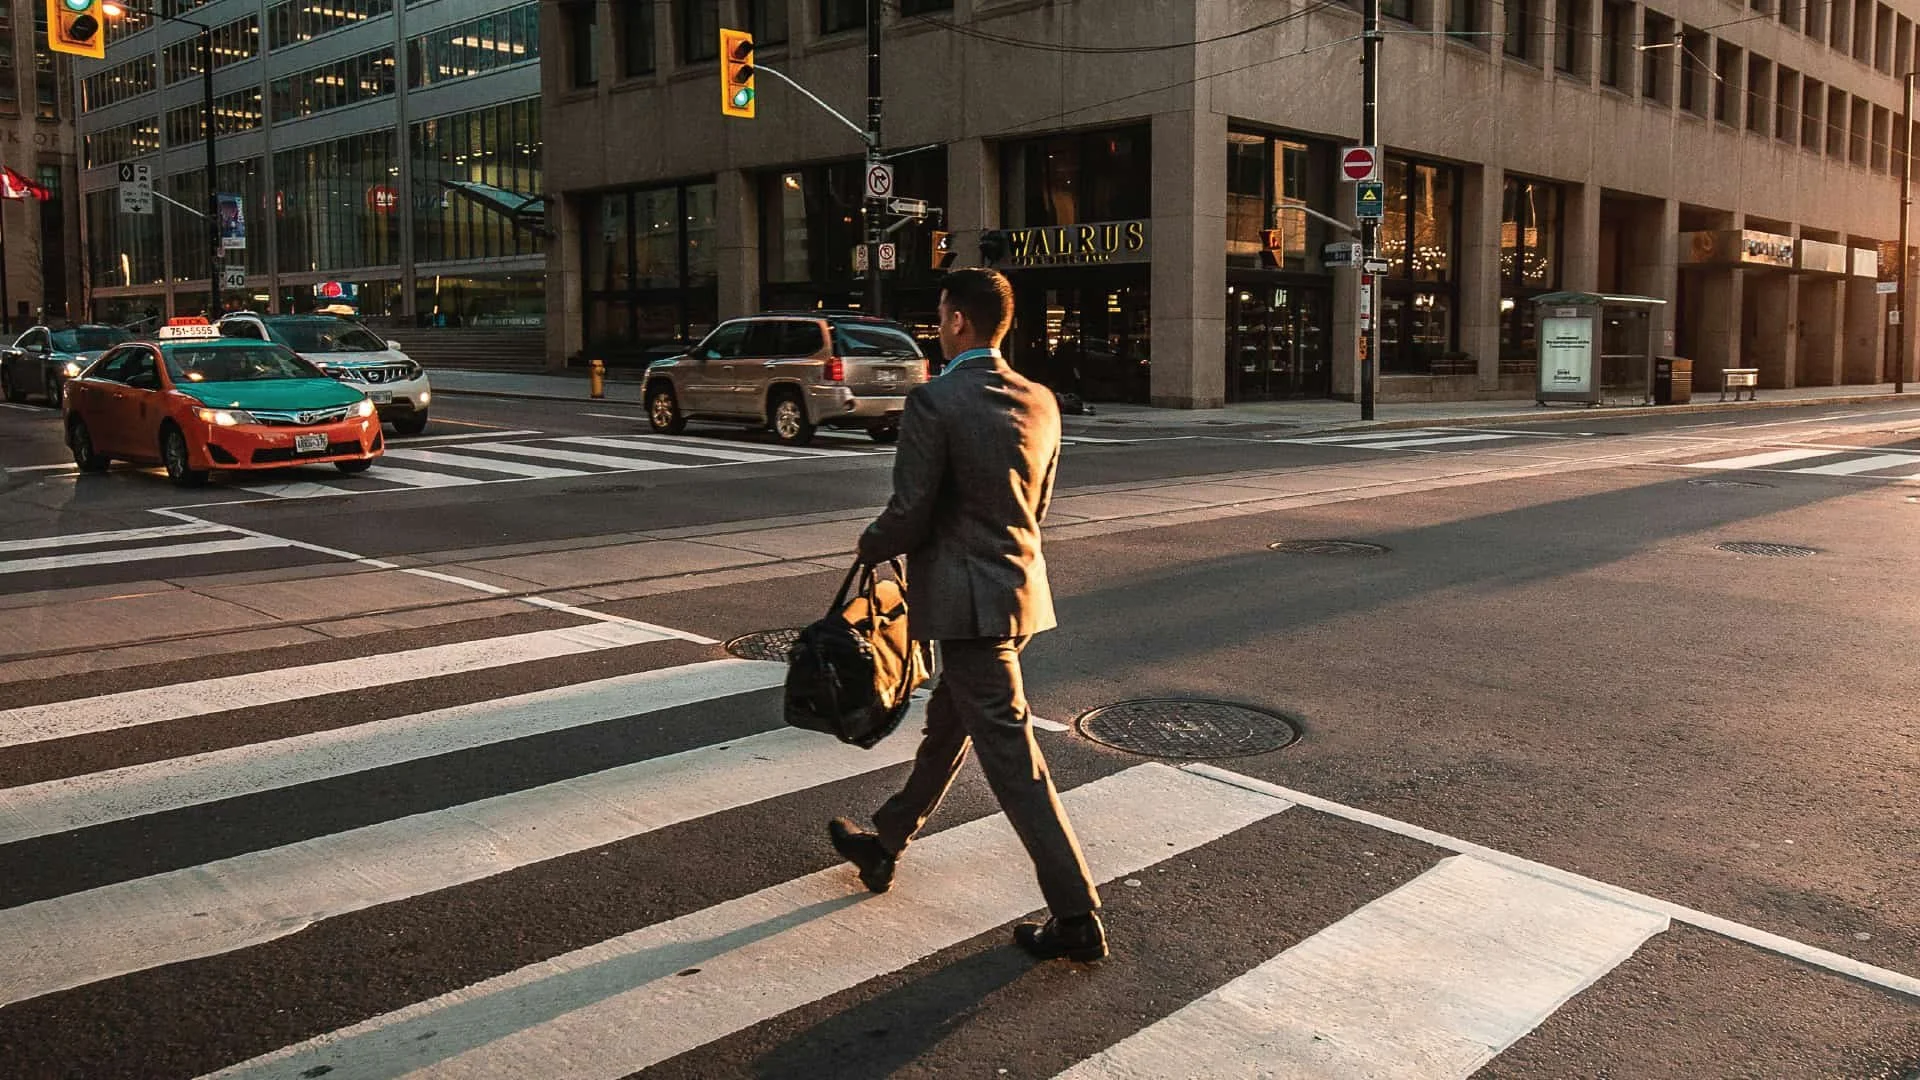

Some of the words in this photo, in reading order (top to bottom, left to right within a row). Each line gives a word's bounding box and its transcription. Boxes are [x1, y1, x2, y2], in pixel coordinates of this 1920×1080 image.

[0, 129, 21, 144] K
[1009, 221, 1144, 257] WALRUS
[227, 274, 245, 286] 40
[170, 326, 213, 336] 751-5555
